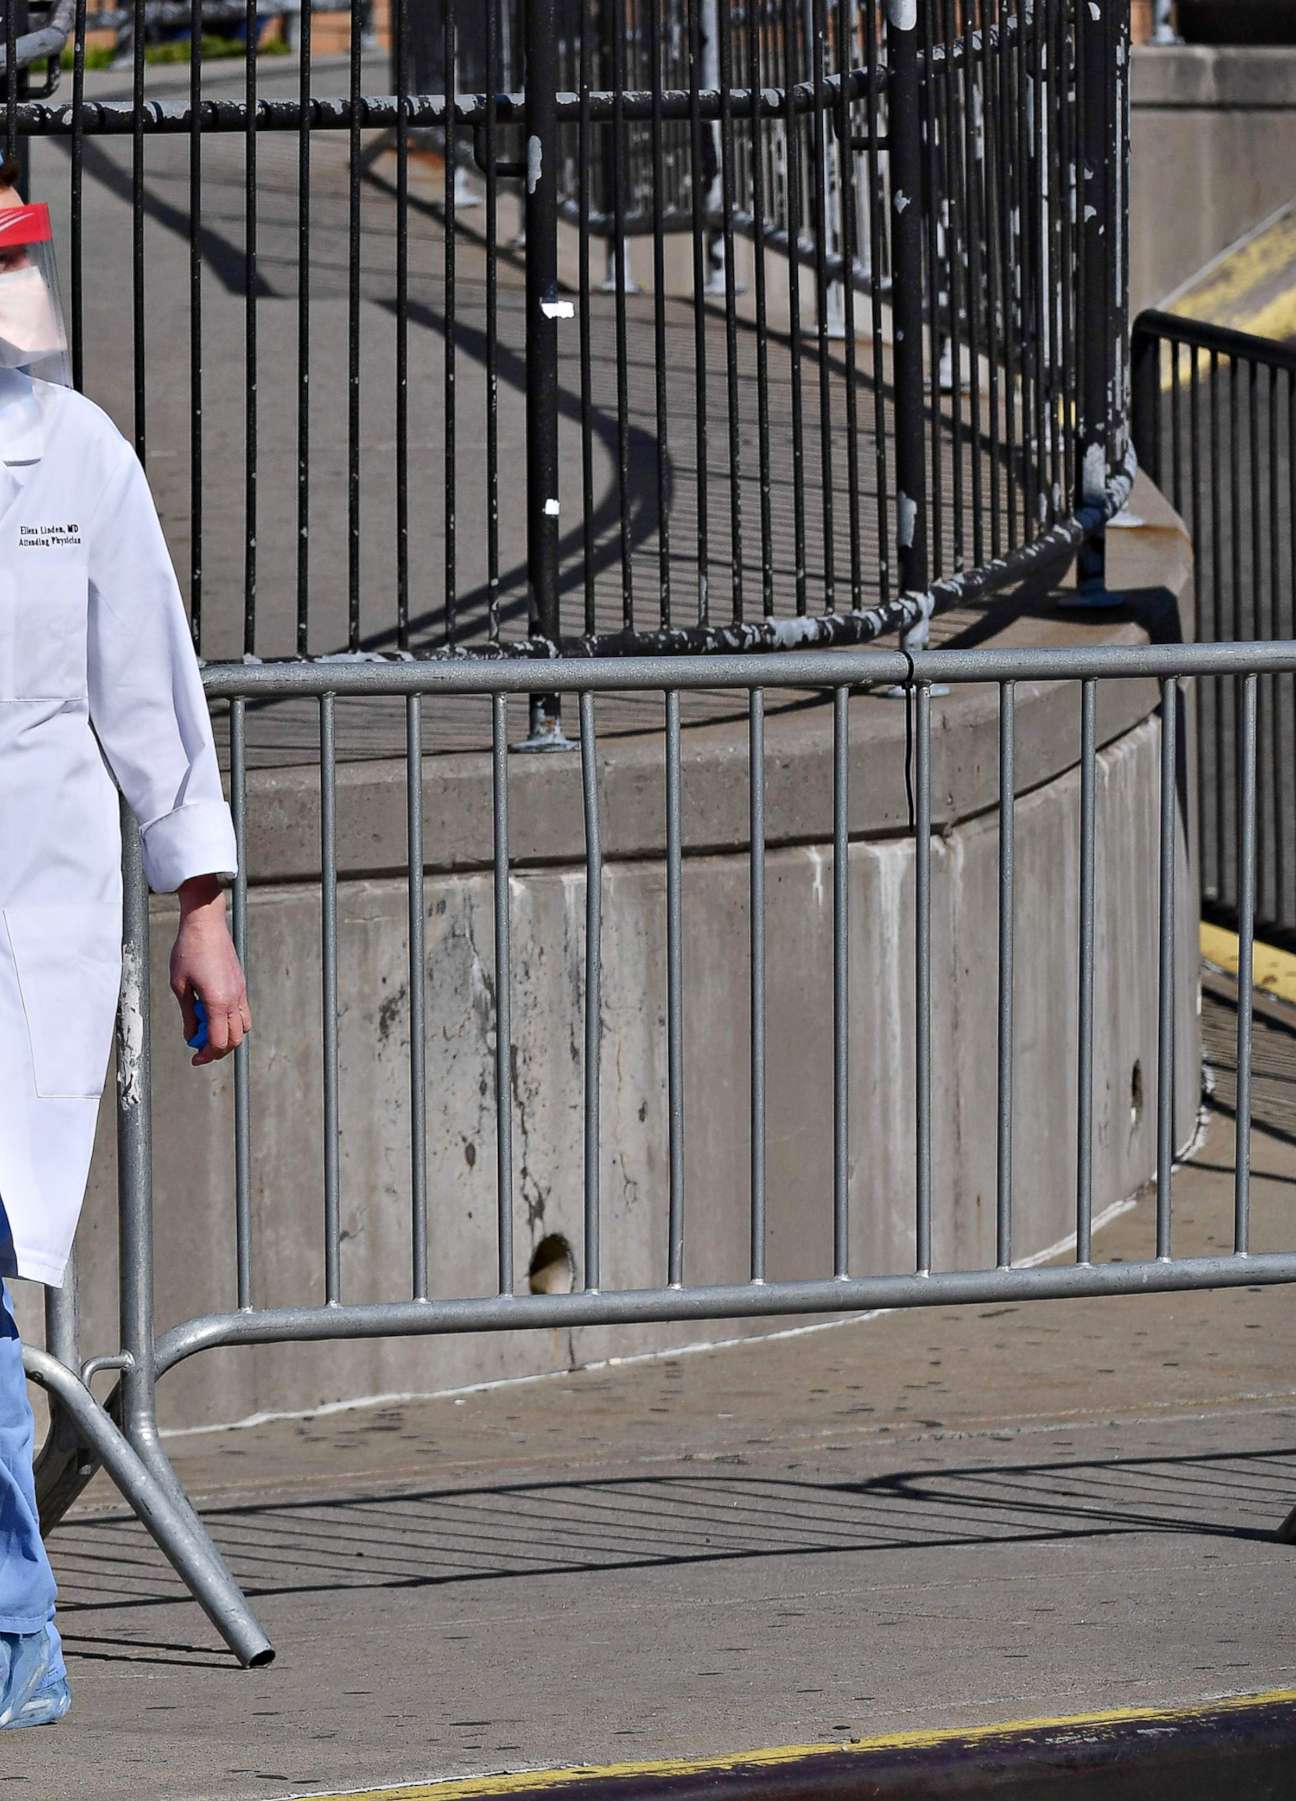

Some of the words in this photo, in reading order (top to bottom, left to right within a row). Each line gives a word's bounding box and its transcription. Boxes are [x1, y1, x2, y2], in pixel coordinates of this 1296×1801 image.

[67, 524, 79, 533] MD
[19, 538, 50, 547] Attending
[51, 536, 81, 547] Physician
